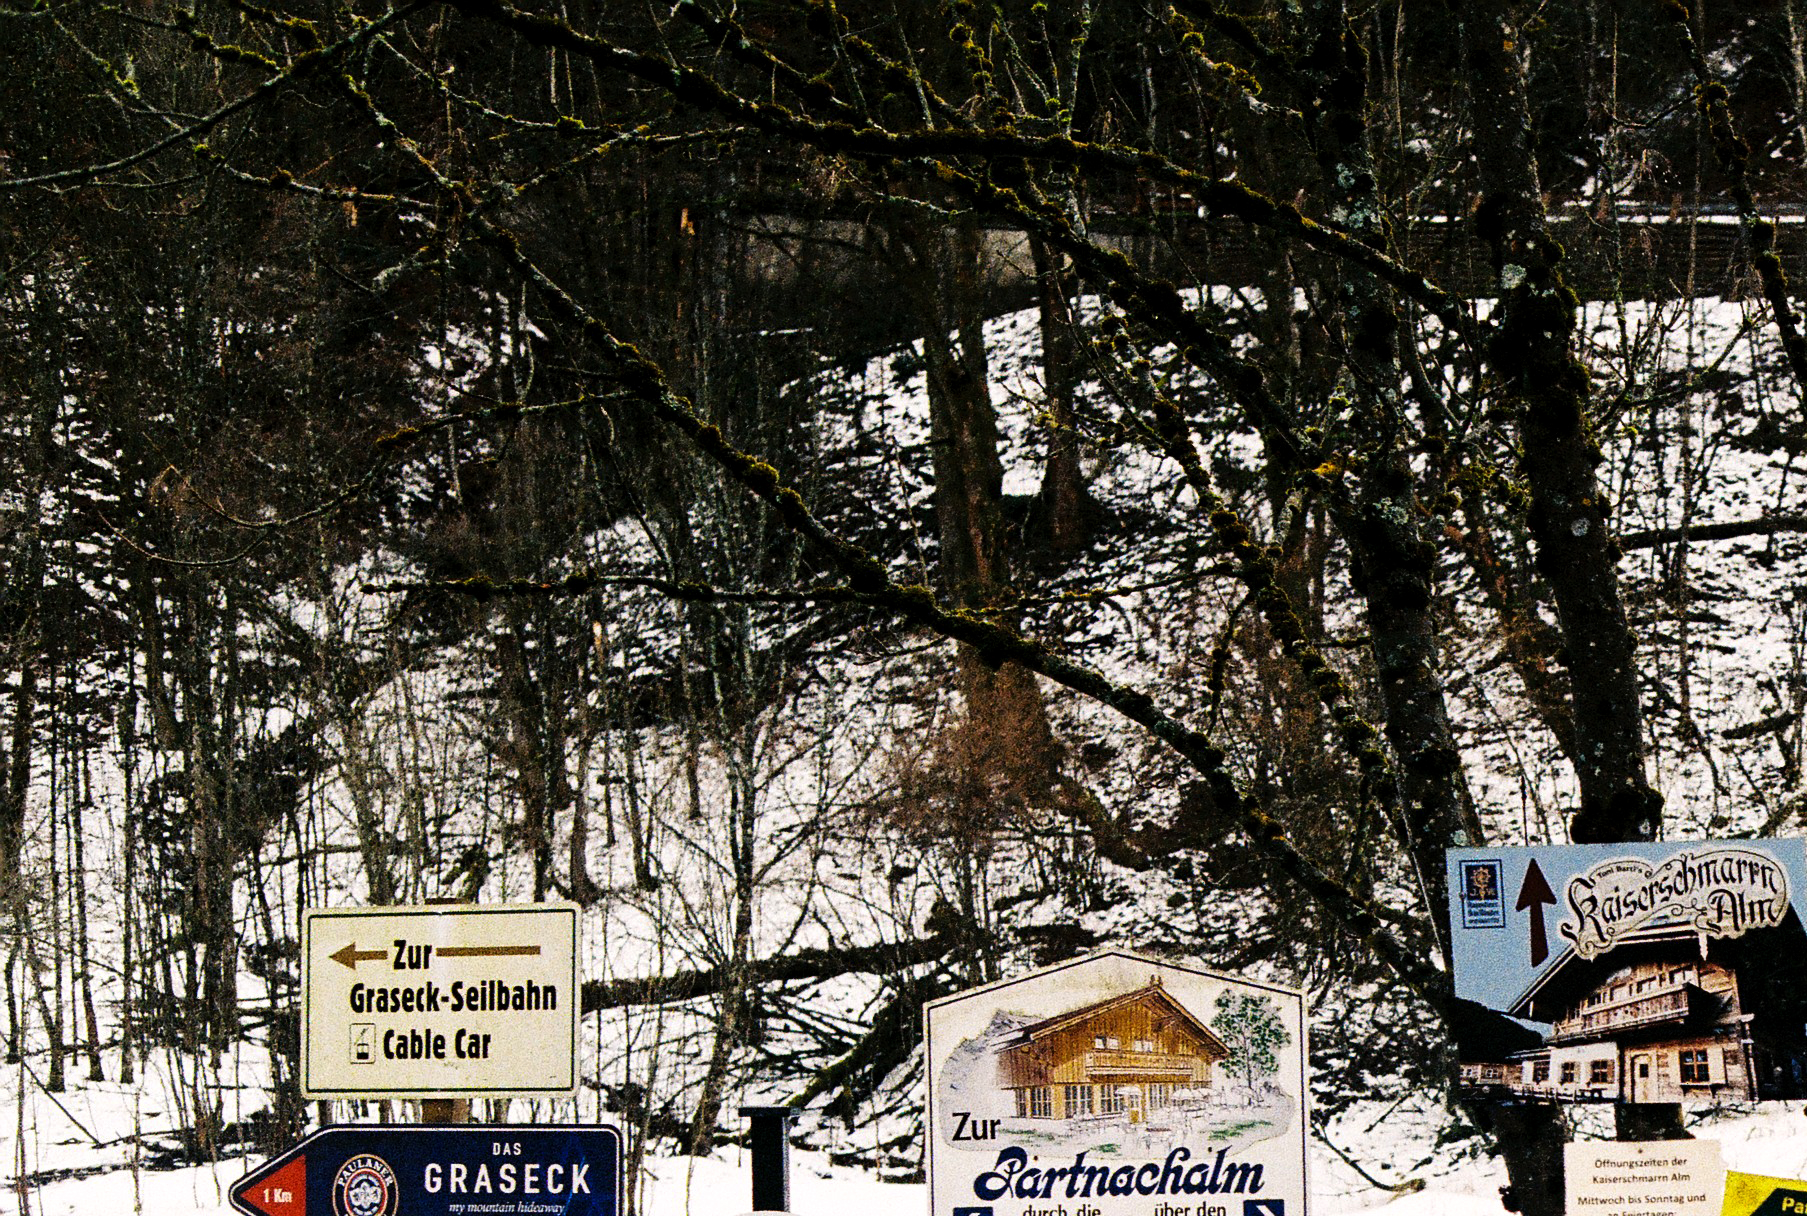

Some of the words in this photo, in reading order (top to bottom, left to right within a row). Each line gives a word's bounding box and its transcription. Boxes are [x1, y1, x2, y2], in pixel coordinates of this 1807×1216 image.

[1560, 852, 1778, 951] Kaiserschmarrn
[1696, 888, 1781, 933] Alm
[392, 939, 433, 971] Zur
[349, 981, 557, 1013] Graseck-Seilbahn
[383, 1029, 446, 1060] Cable
[453, 1030, 491, 1060] Car
[952, 1112, 1001, 1142] Zur
[493, 1142, 522, 1156] DAS
[1671, 1158, 1688, 1167] der
[337, 1158, 394, 1187] PAULANER
[424, 1163, 591, 1194] GRASECK
[973, 1145, 1265, 1201] Partnachalm
[1671, 1173, 1691, 1182] Alm
[263, 1188, 270, 1203] 1
[274, 1188, 293, 1203] Km
[449, 1205, 465, 1215] my
[467, 1202, 515, 1213] mountain
[518, 1201, 566, 1216] hideaway
[1577, 1196, 1625, 1206] Mittwoch
[1628, 1195, 1642, 1204] bis
[1644, 1195, 1685, 1205] Sonntag
[1687, 1194, 1706, 1202] und
